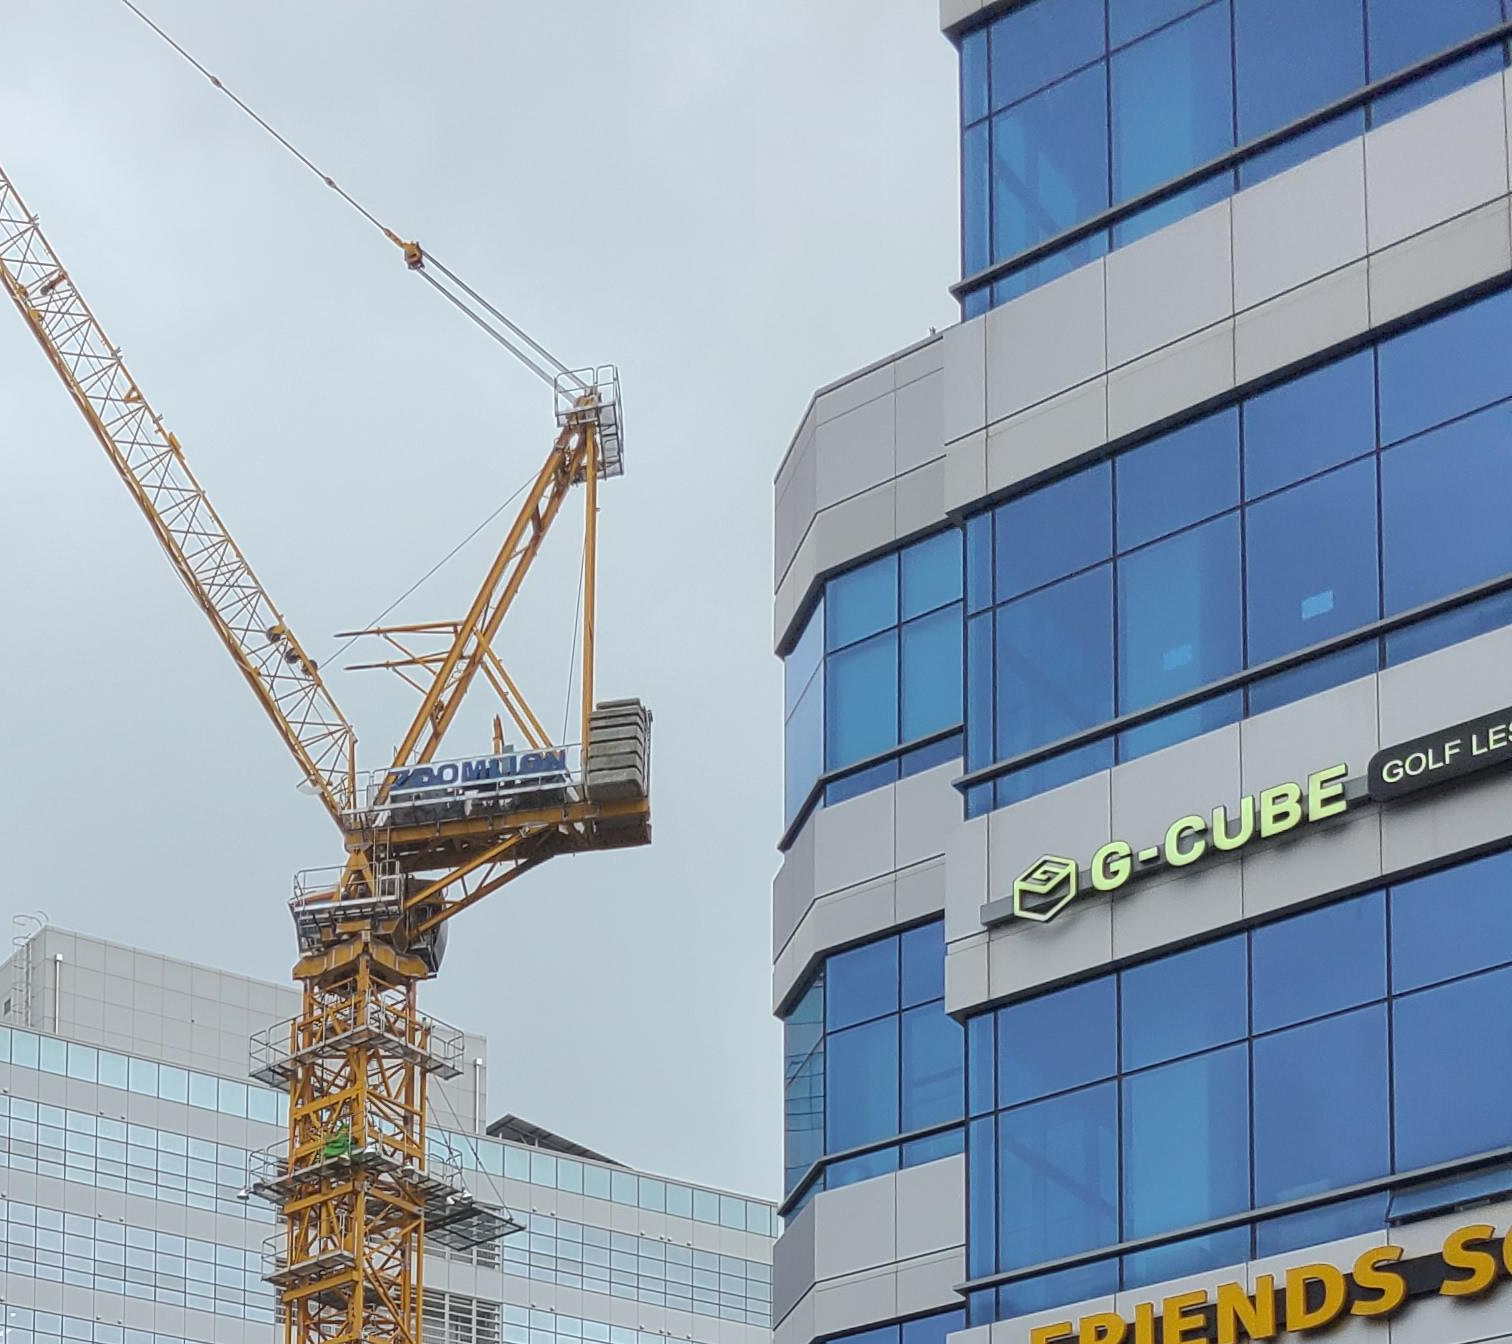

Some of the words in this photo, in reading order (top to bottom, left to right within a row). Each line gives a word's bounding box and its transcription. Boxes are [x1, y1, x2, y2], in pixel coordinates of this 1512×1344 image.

[1381, 738, 1462, 783] GOLF
[1471, 721, 1512, 756] LE
[1090, 762, 1349, 892] G-CUBE
[1439, 1224, 1512, 1298] S
